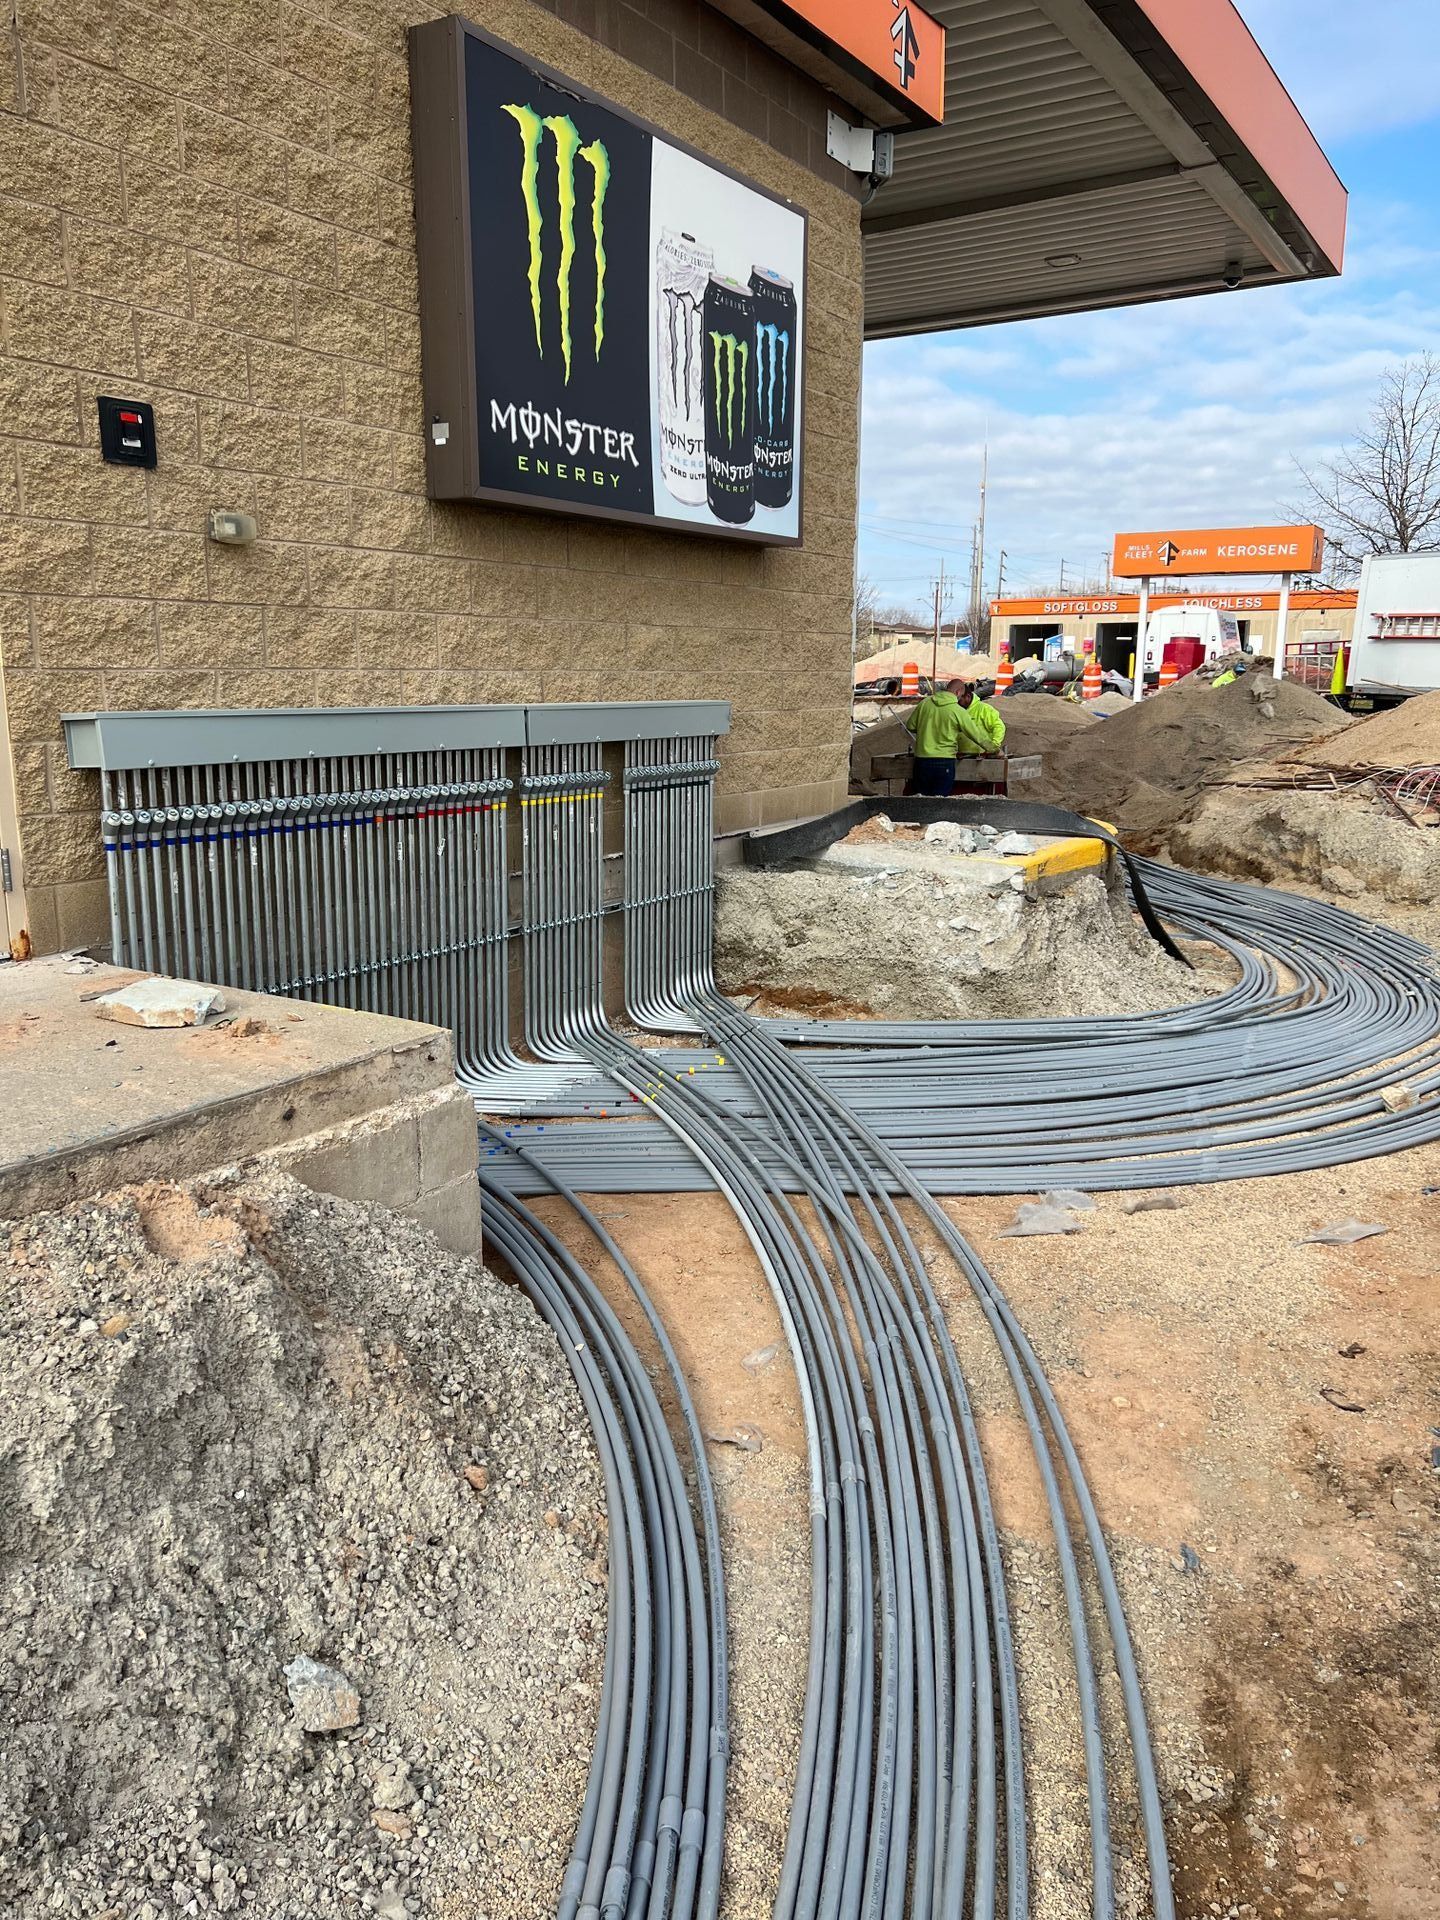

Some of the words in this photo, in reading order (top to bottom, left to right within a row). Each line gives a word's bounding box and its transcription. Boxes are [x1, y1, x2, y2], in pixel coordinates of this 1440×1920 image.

[490, 399, 640, 467] MONSTER
[660, 422, 705, 456] MONST
[754, 442, 793, 468] ONSTER
[517, 455, 621, 488] ENERGY
[669, 465, 687, 478] ZERO
[689, 473, 706, 481] ULTR
[1125, 550, 1154, 559] FLEET
[1181, 548, 1208, 557] FARM
[1217, 543, 1299, 557] KEROSENE
[1043, 601, 1118, 612] SOFTGLOSS
